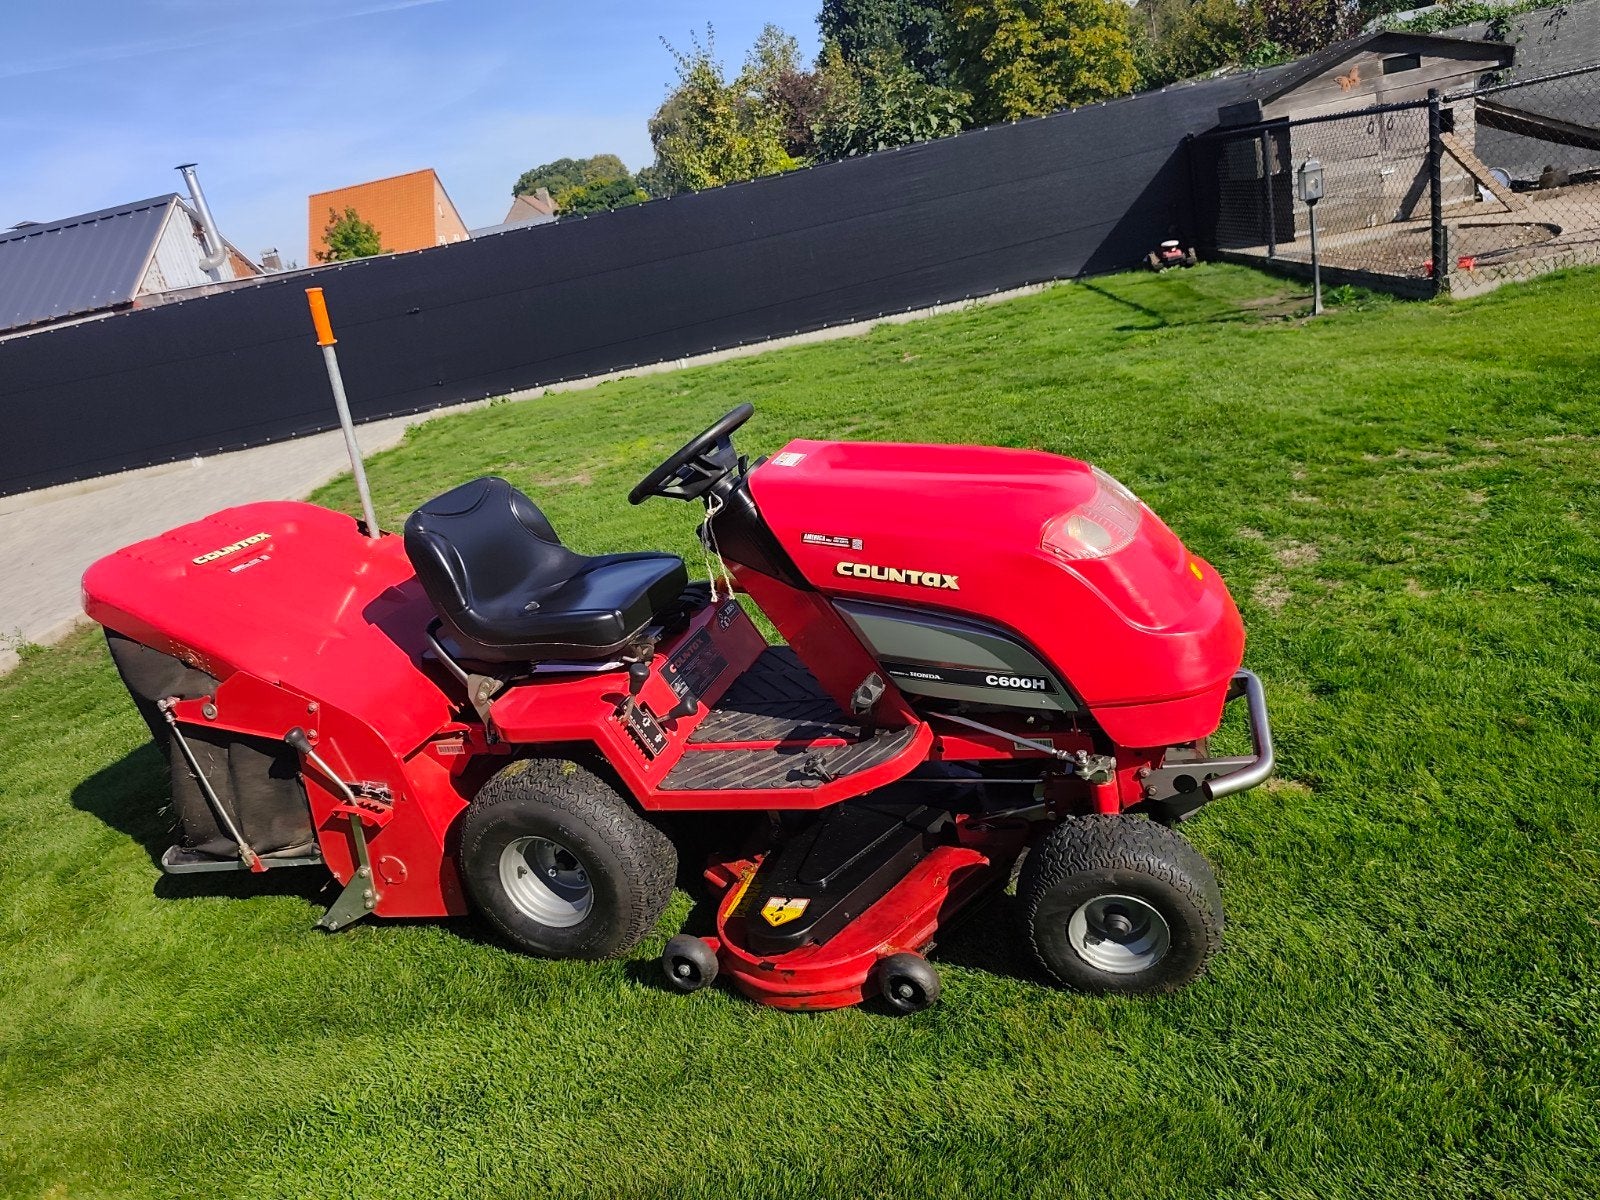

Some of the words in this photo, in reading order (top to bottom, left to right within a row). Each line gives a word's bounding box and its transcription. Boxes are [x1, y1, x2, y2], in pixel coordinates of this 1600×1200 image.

[836, 561, 960, 591] COUNTAX
[909, 671, 941, 680] HONDA
[985, 675, 1046, 690] C600H
